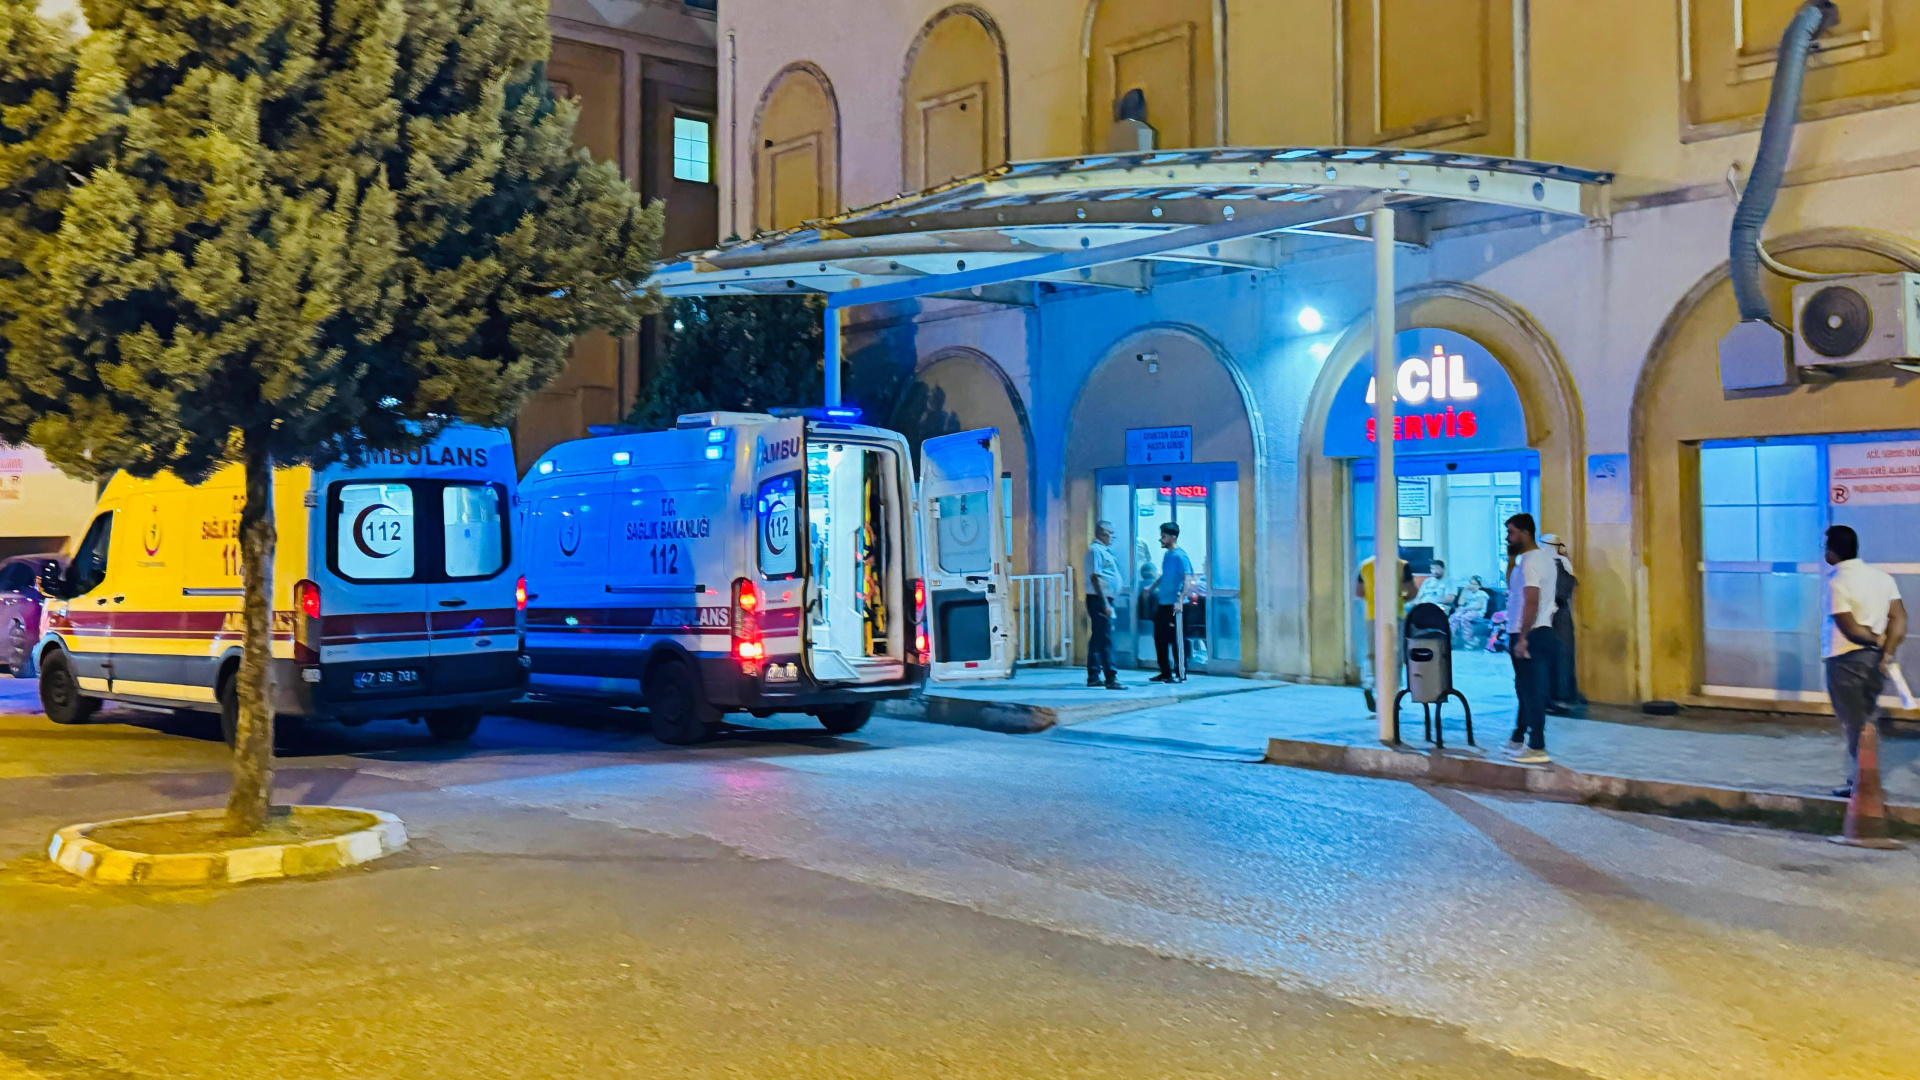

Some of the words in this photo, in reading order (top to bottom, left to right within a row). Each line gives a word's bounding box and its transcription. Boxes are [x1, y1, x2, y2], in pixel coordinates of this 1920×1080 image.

[364, 446, 488, 467] MBULANS
[762, 436, 800, 464] AMBU
[661, 497, 677, 517] T.C.
[365, 521, 401, 542] 112
[626, 518, 658, 541] SAĞLIK
[660, 515, 710, 539] BAKANLIĞI
[770, 516, 789, 538] 112
[222, 545, 244, 576] 11
[650, 544, 678, 575] 112
[651, 607, 730, 627] AMBULANS
